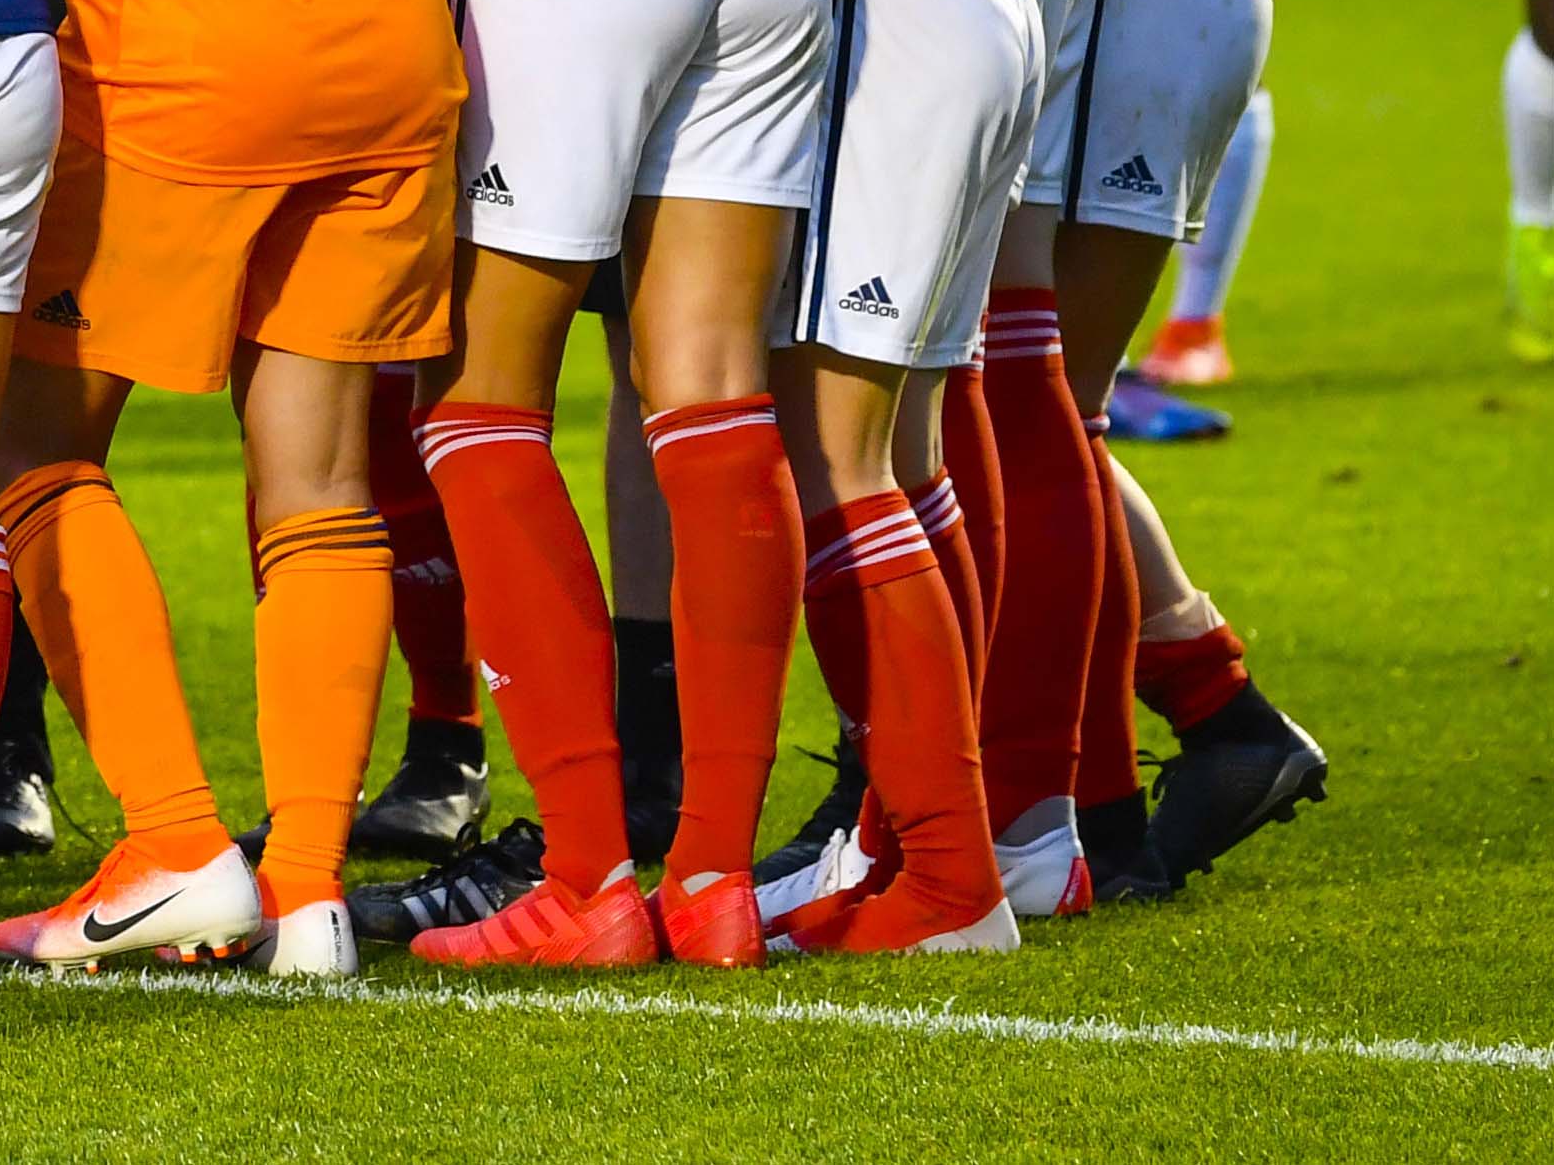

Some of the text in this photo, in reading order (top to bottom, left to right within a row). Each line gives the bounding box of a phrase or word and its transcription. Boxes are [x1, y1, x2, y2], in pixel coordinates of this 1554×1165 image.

[466, 186, 514, 207] adidas
[1102, 176, 1164, 196] adidas
[838, 298, 900, 319] adidas
